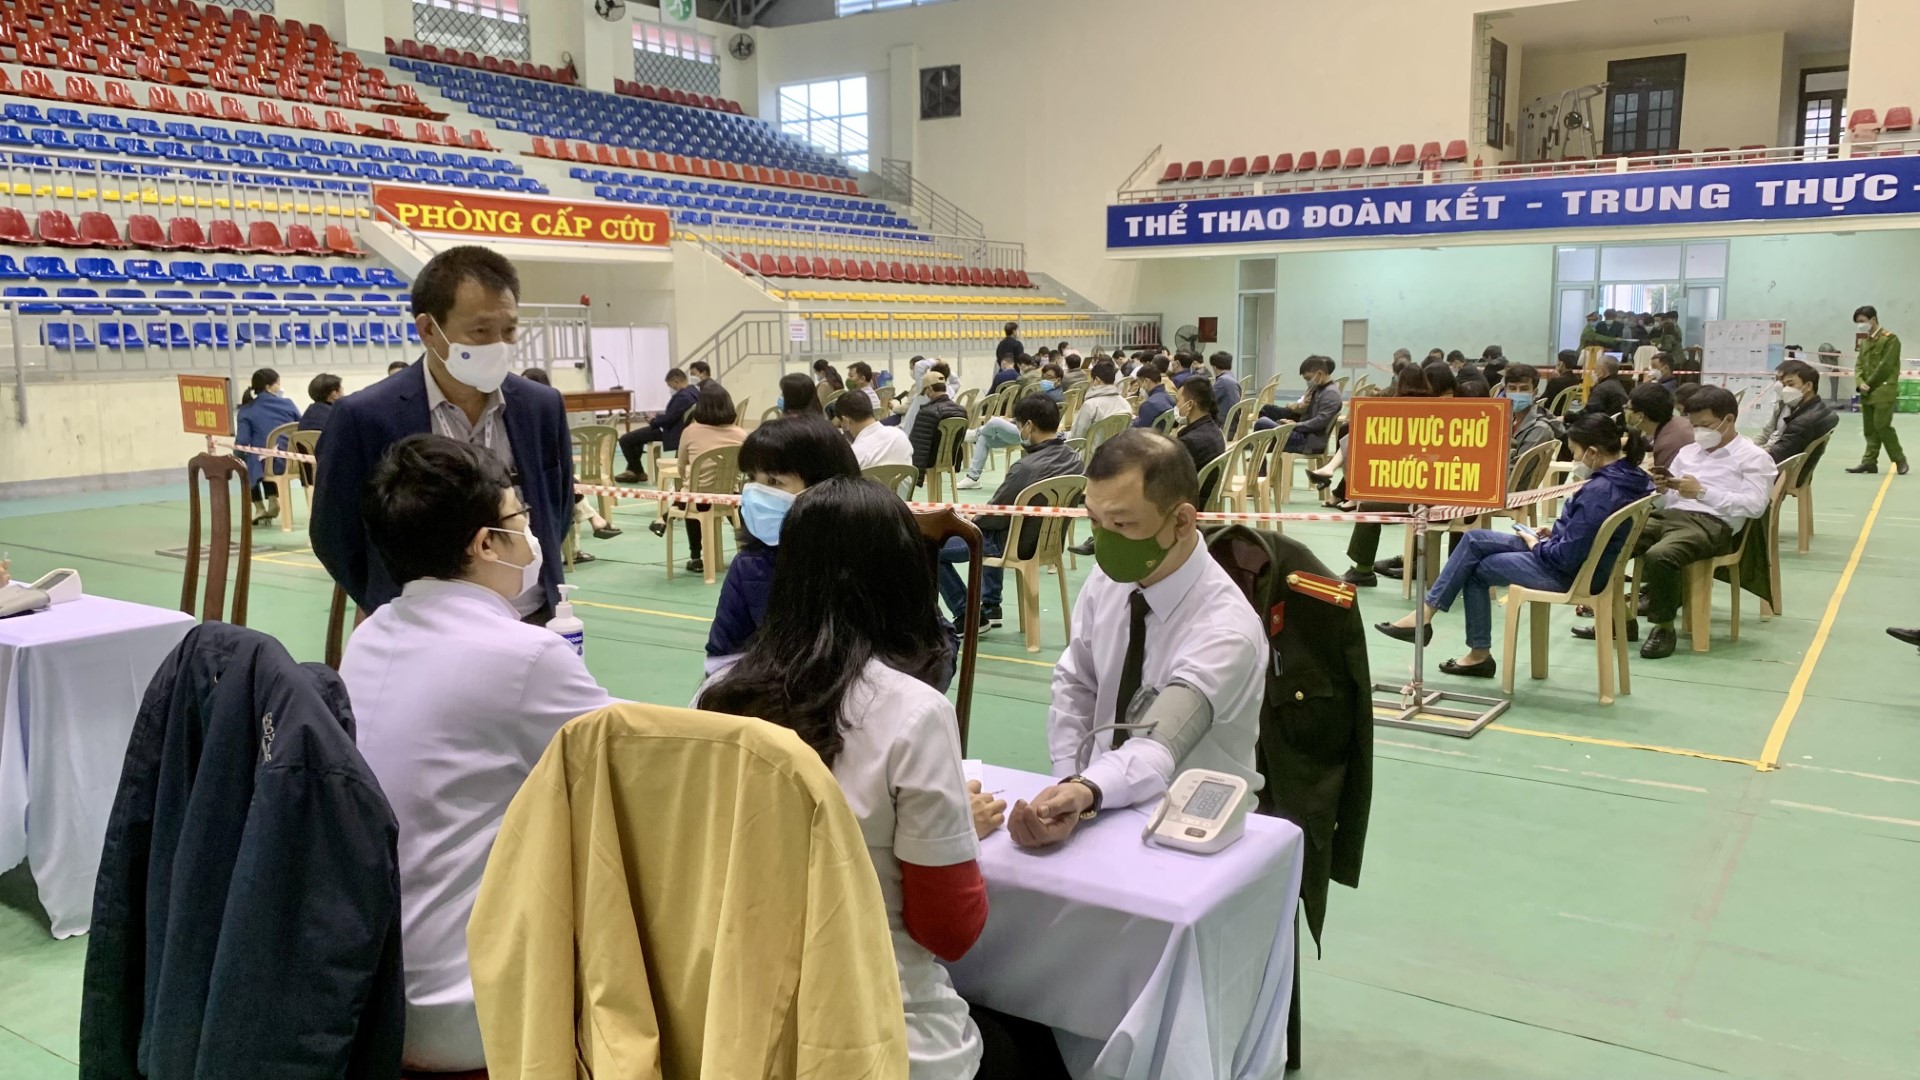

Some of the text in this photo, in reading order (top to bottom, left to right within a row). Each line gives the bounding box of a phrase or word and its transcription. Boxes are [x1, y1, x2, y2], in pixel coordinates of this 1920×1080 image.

[395, 200, 656, 241] PHÒNG CẤP CỨU
[1125, 204, 1187, 237] THỂ
[1198, 207, 1290, 233] THAO
[1302, 197, 1412, 228] ĐOÀN
[1425, 188, 1505, 222] KẾT
[1562, 183, 1730, 215] TRUNG
[1755, 173, 1898, 211] THỰC
[1365, 411, 1490, 452] KHU VỰC CHỜ
[1368, 454, 1481, 491] TRƯỚC TIÊM
